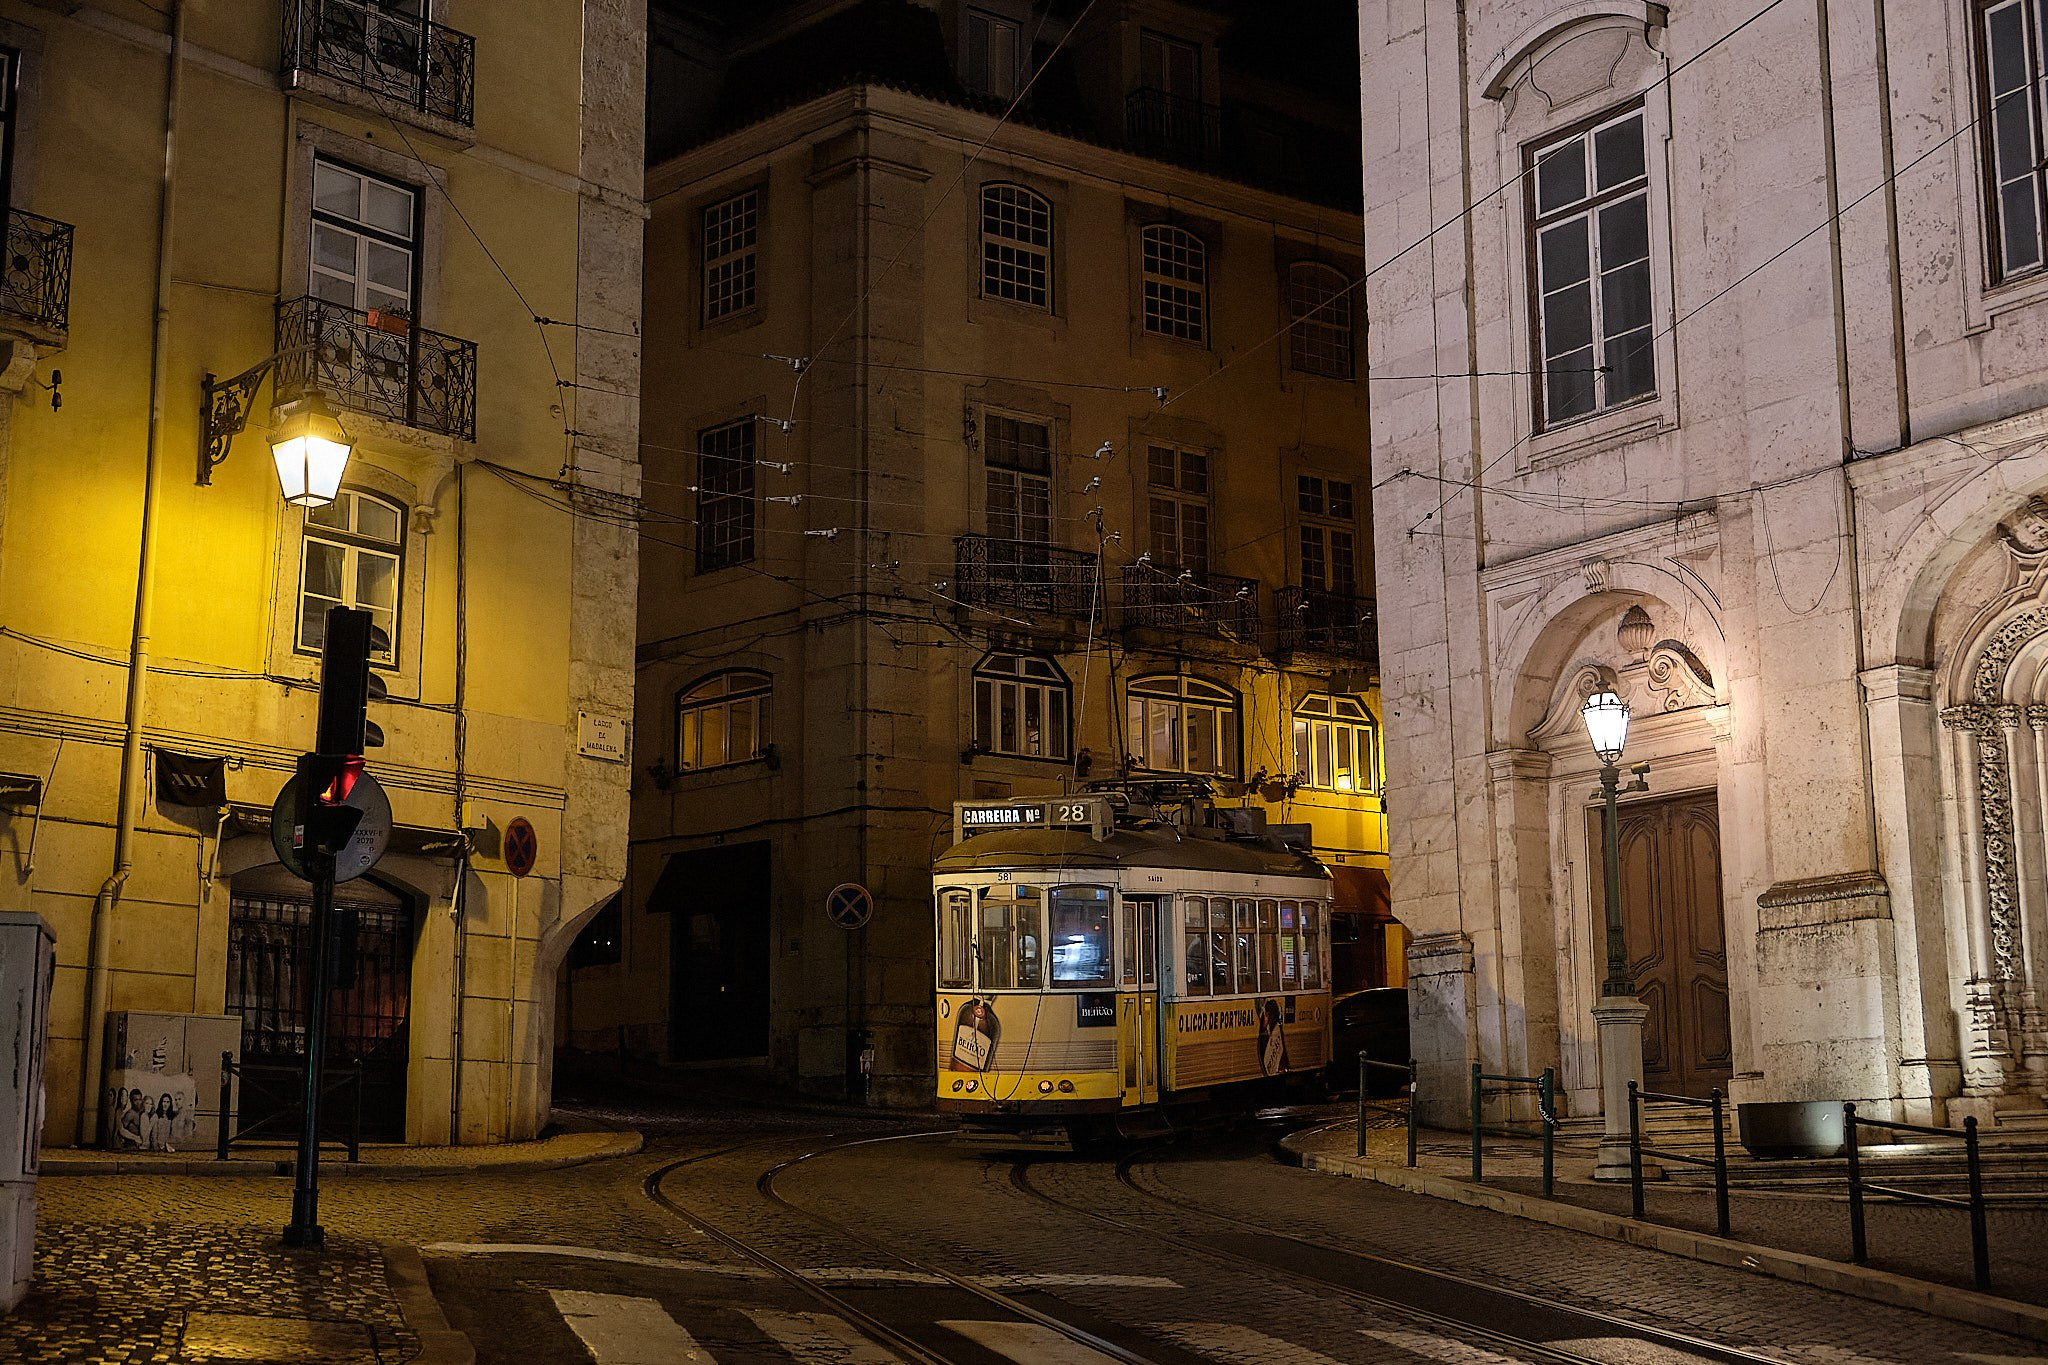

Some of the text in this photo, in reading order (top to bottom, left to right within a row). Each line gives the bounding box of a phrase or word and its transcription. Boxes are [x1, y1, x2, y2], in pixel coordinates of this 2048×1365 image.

[586, 741, 617, 753] MADALENA
[963, 808, 1041, 824] CARREIRA Nº
[1058, 804, 1085, 822] 28
[997, 872, 1012, 881] 581
[1178, 1009, 1255, 1033] O LICOR DE PORTUGAL
